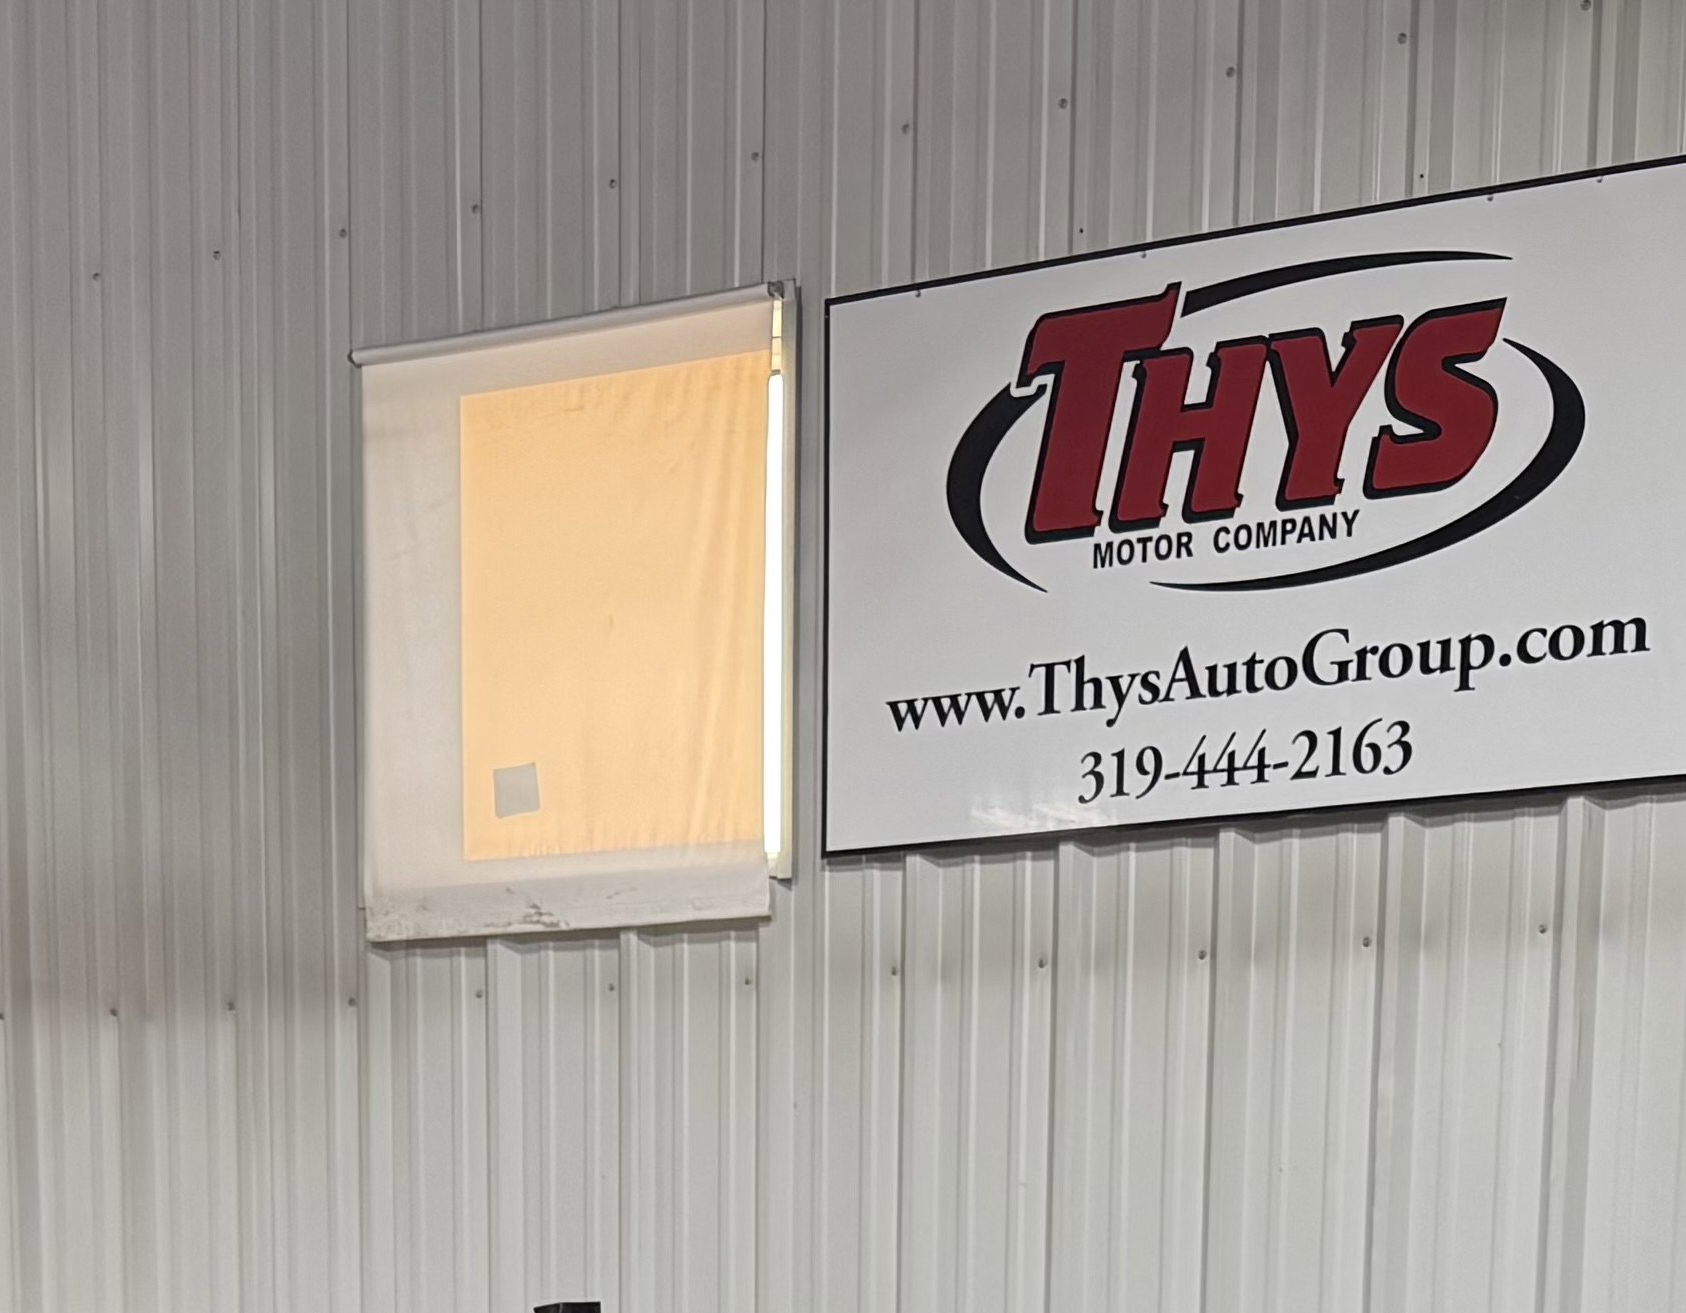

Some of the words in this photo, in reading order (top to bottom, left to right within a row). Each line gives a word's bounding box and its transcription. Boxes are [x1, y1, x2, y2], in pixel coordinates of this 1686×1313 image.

[1017, 281, 1508, 545] THYS
[1091, 531, 1194, 570] MOTOR
[1213, 509, 1360, 554] COMPANY
[886, 614, 1651, 733] www.ThysAutoGroup.com
[1078, 718, 1414, 804] 319-444-2163
